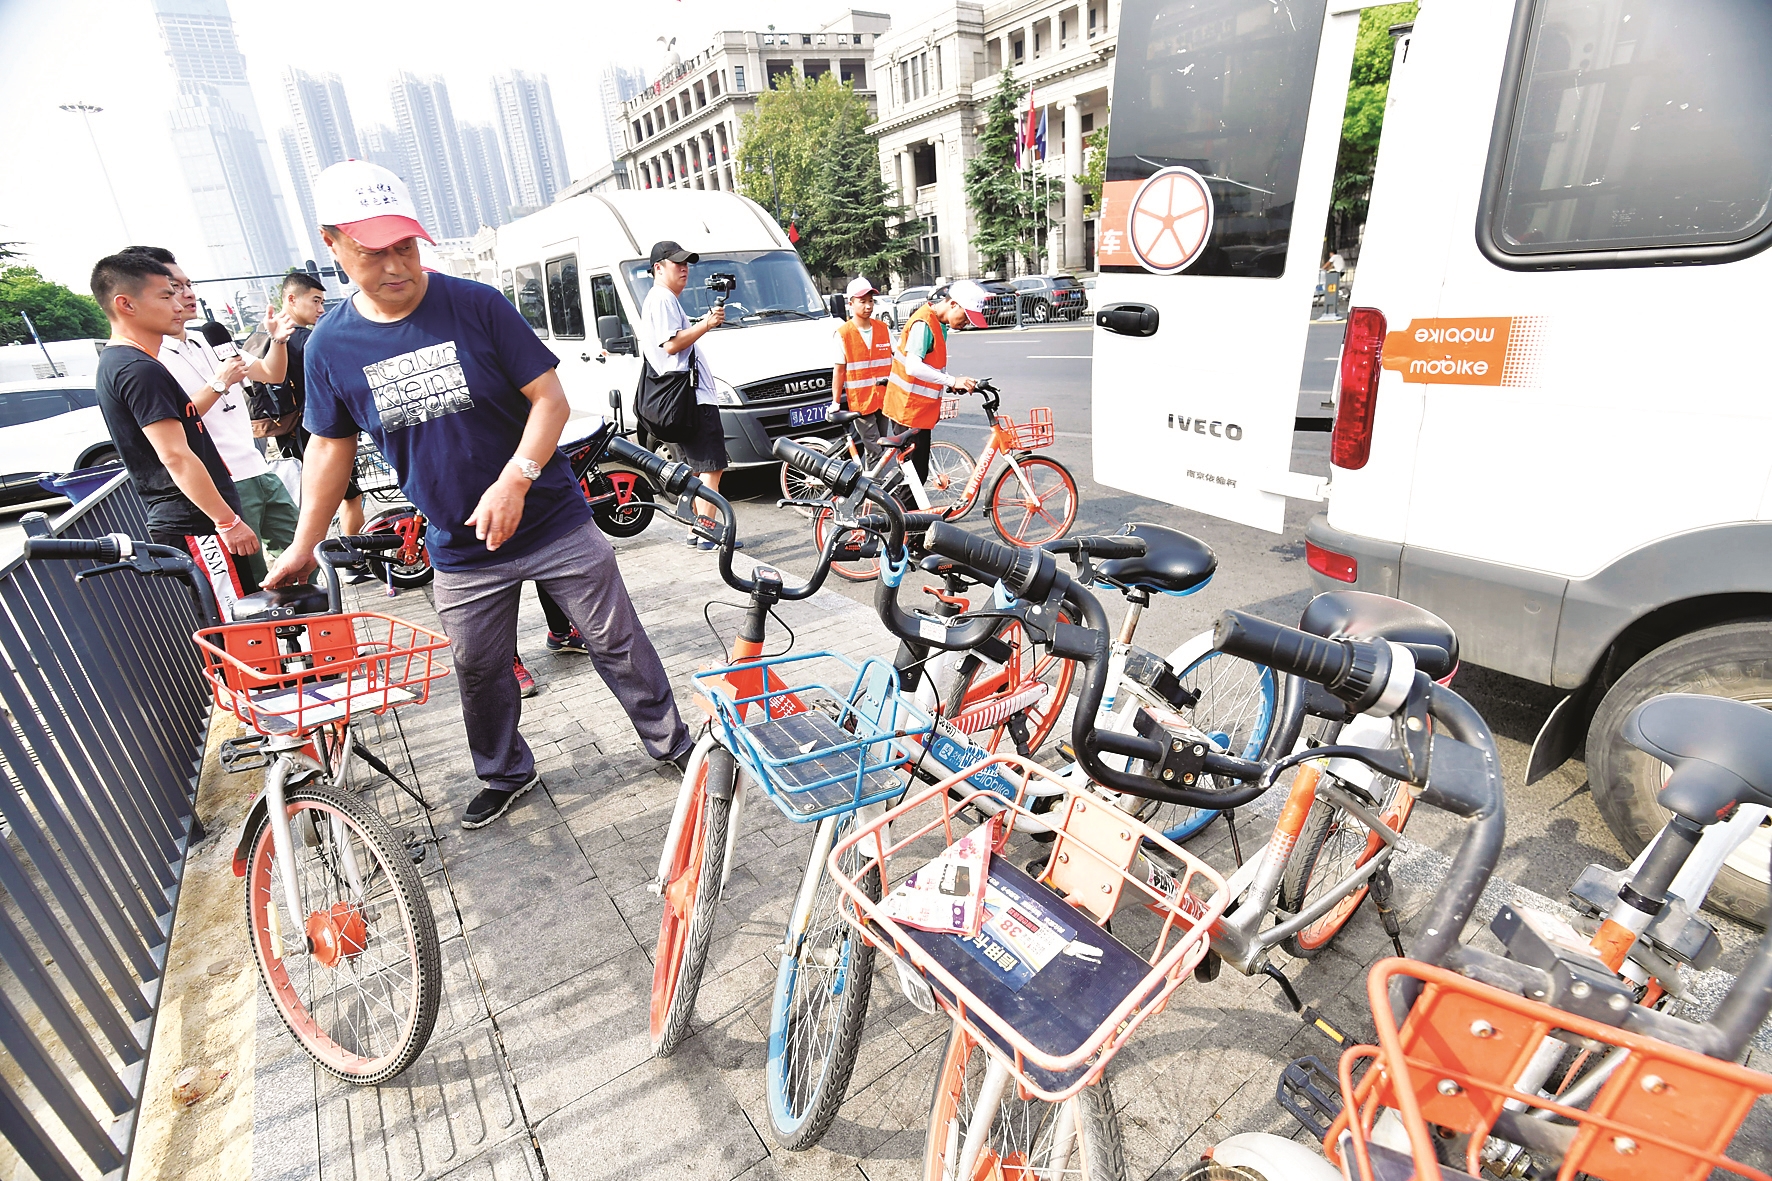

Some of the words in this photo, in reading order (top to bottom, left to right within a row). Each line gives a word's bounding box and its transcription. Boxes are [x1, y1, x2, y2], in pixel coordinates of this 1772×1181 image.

[1100, 229, 1123, 255] 车
[1414, 327, 1495, 344] mobike
[1409, 355, 1489, 375] mobike
[784, 378, 826, 394] IVECO
[1168, 413, 1243, 441] IVECO
[972, 771, 1010, 797] ellobike
[1000, 919, 1022, 937] 38
